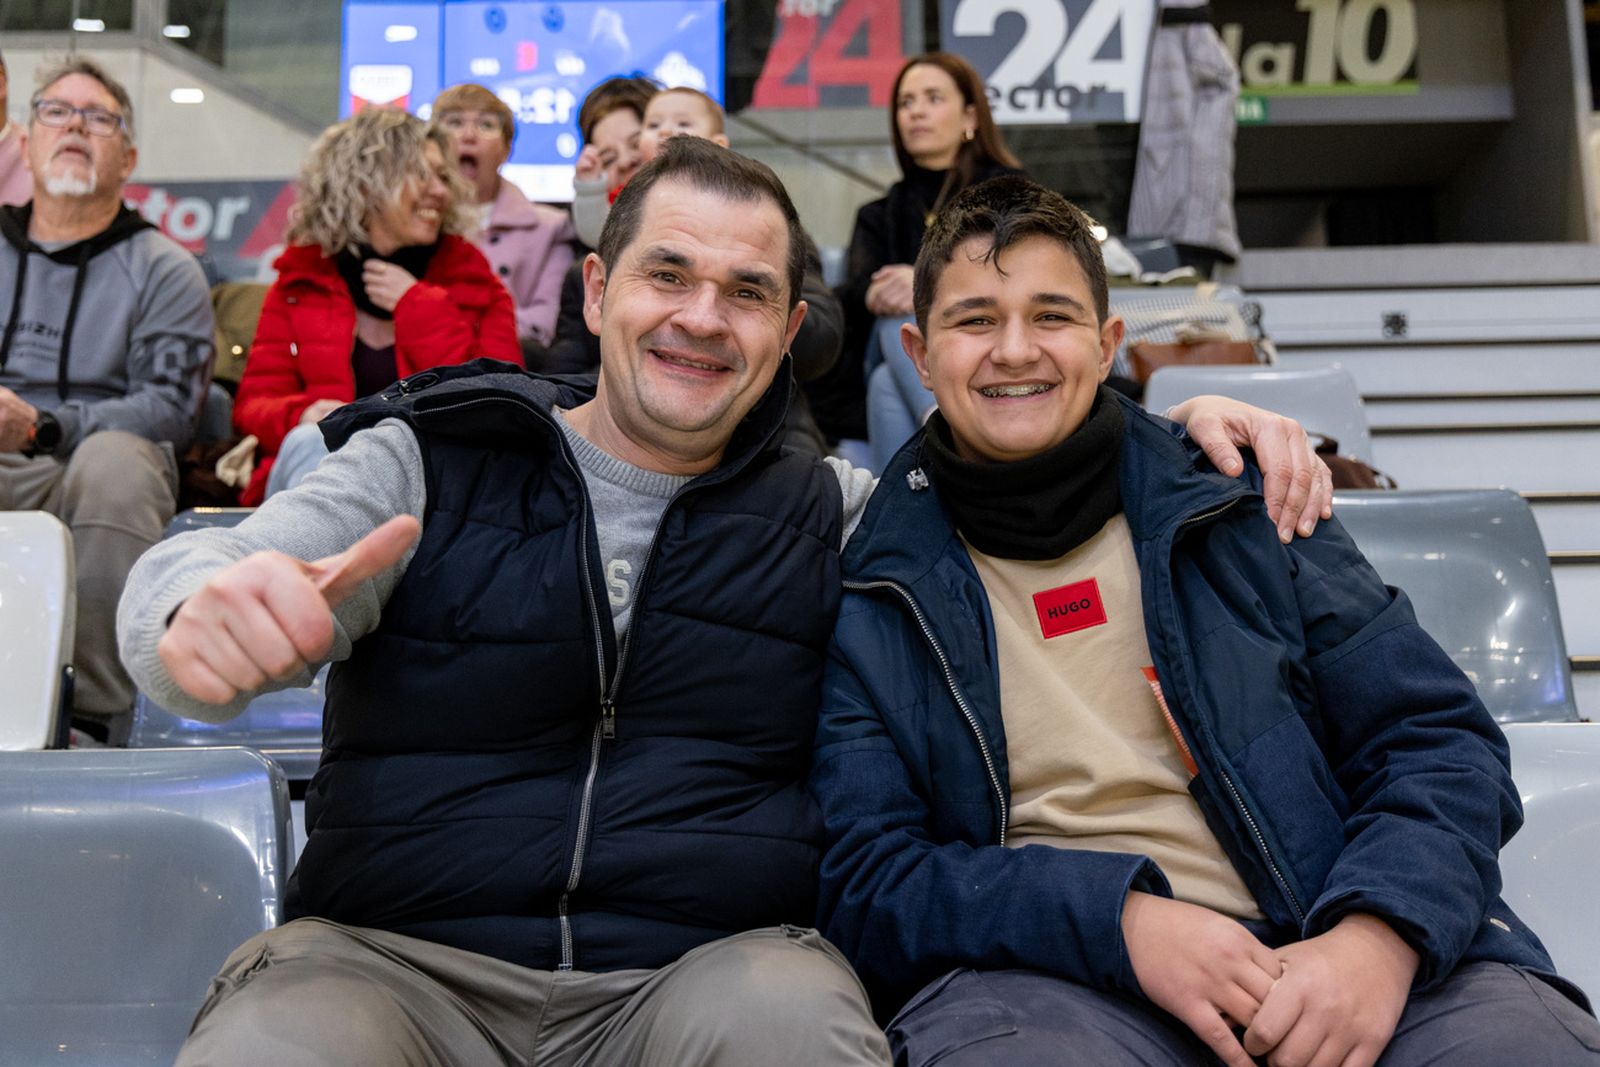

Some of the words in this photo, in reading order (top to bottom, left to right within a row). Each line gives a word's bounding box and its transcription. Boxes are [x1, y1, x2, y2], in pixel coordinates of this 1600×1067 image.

[953, 0, 1153, 124] 24
[124, 188, 250, 240] tor
[607, 559, 632, 606] S
[1047, 598, 1091, 619] HUGO
